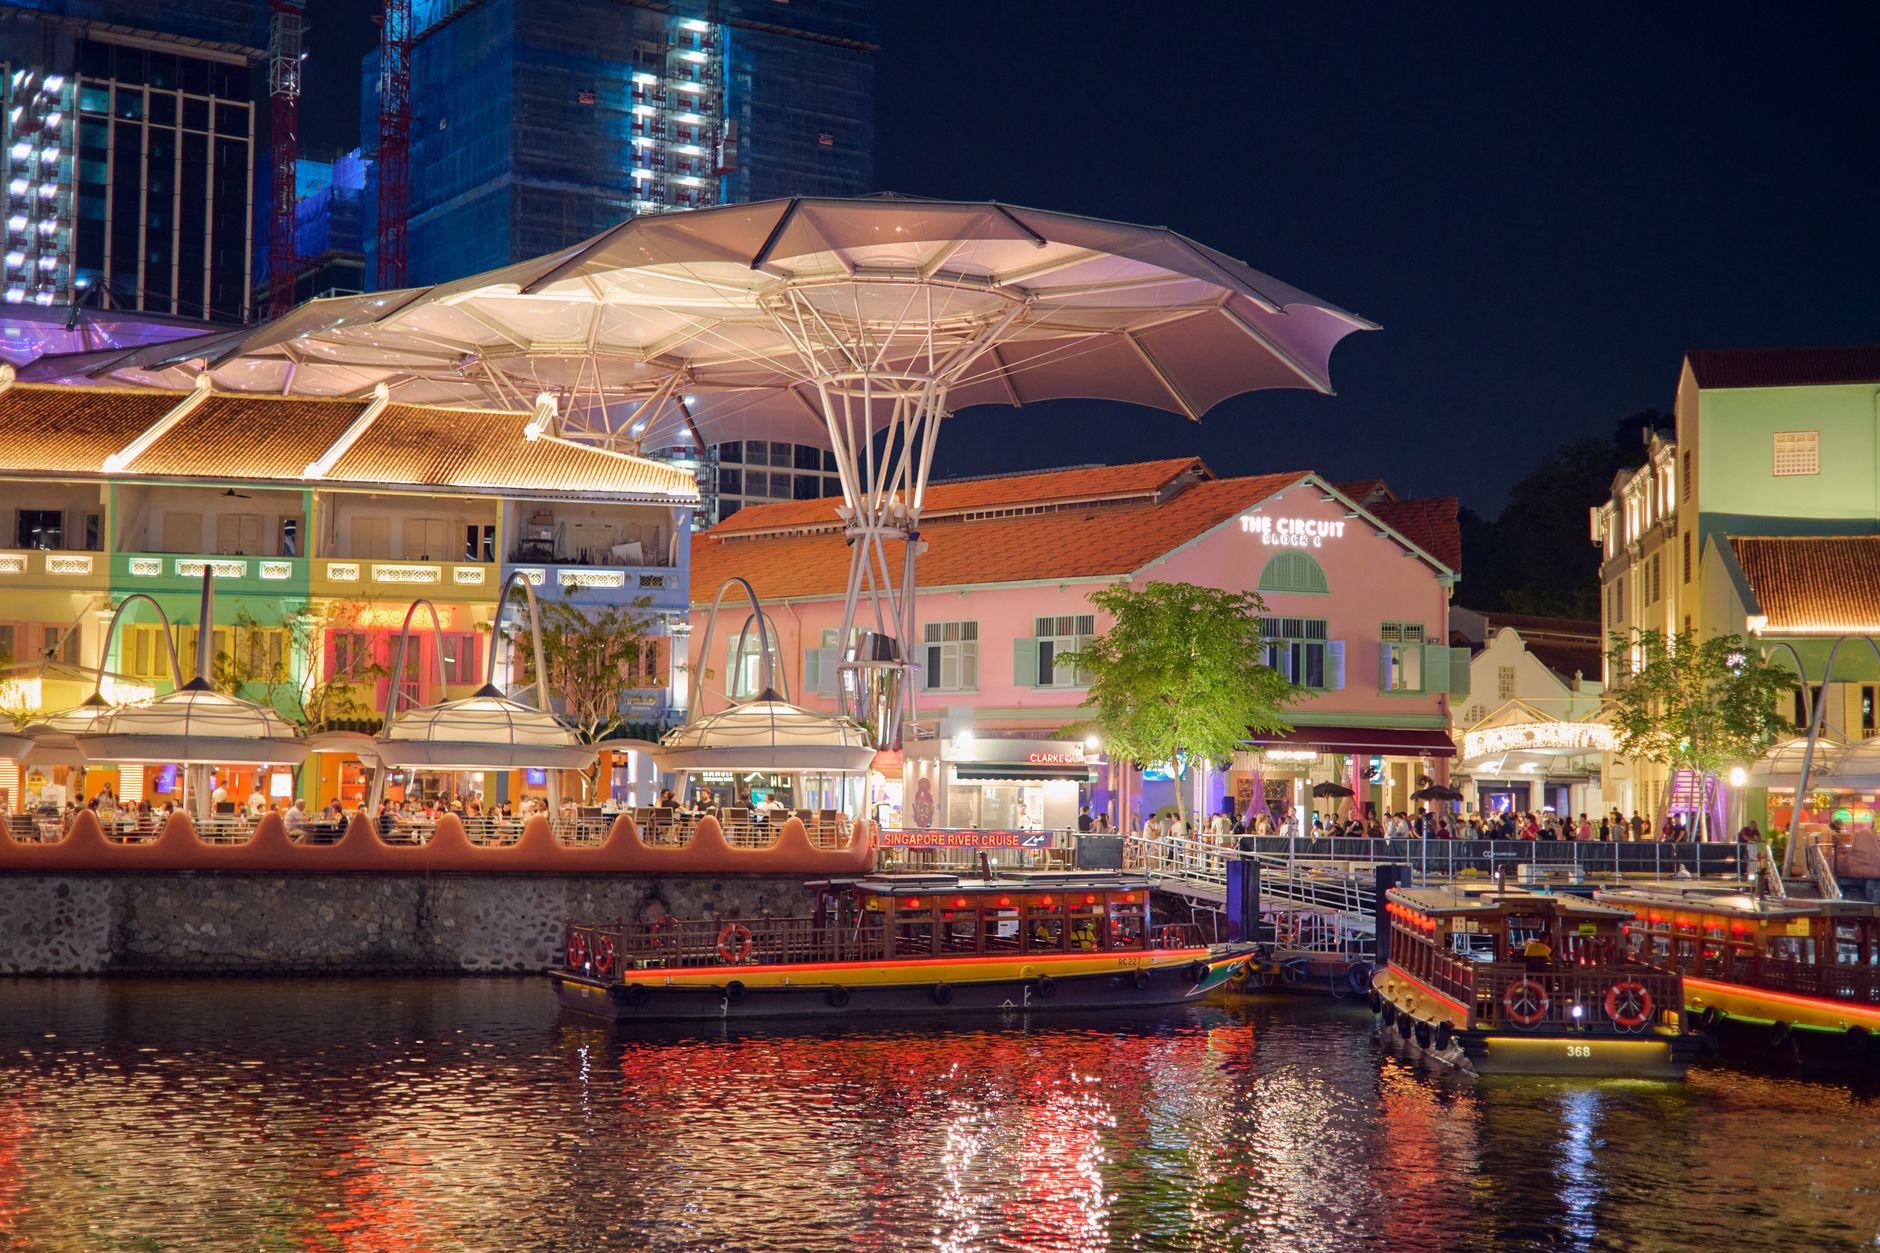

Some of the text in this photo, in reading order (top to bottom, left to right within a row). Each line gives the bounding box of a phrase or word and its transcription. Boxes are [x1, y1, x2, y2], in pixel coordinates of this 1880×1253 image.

[1240, 516, 1345, 538] THE CIRCUIT
[1262, 533, 1308, 546] BLOCK
[1030, 753, 1063, 763] CLARKE
[884, 834, 1019, 846] SINGAPORE RIVER CRUISE
[1567, 1046, 1591, 1057] 368
